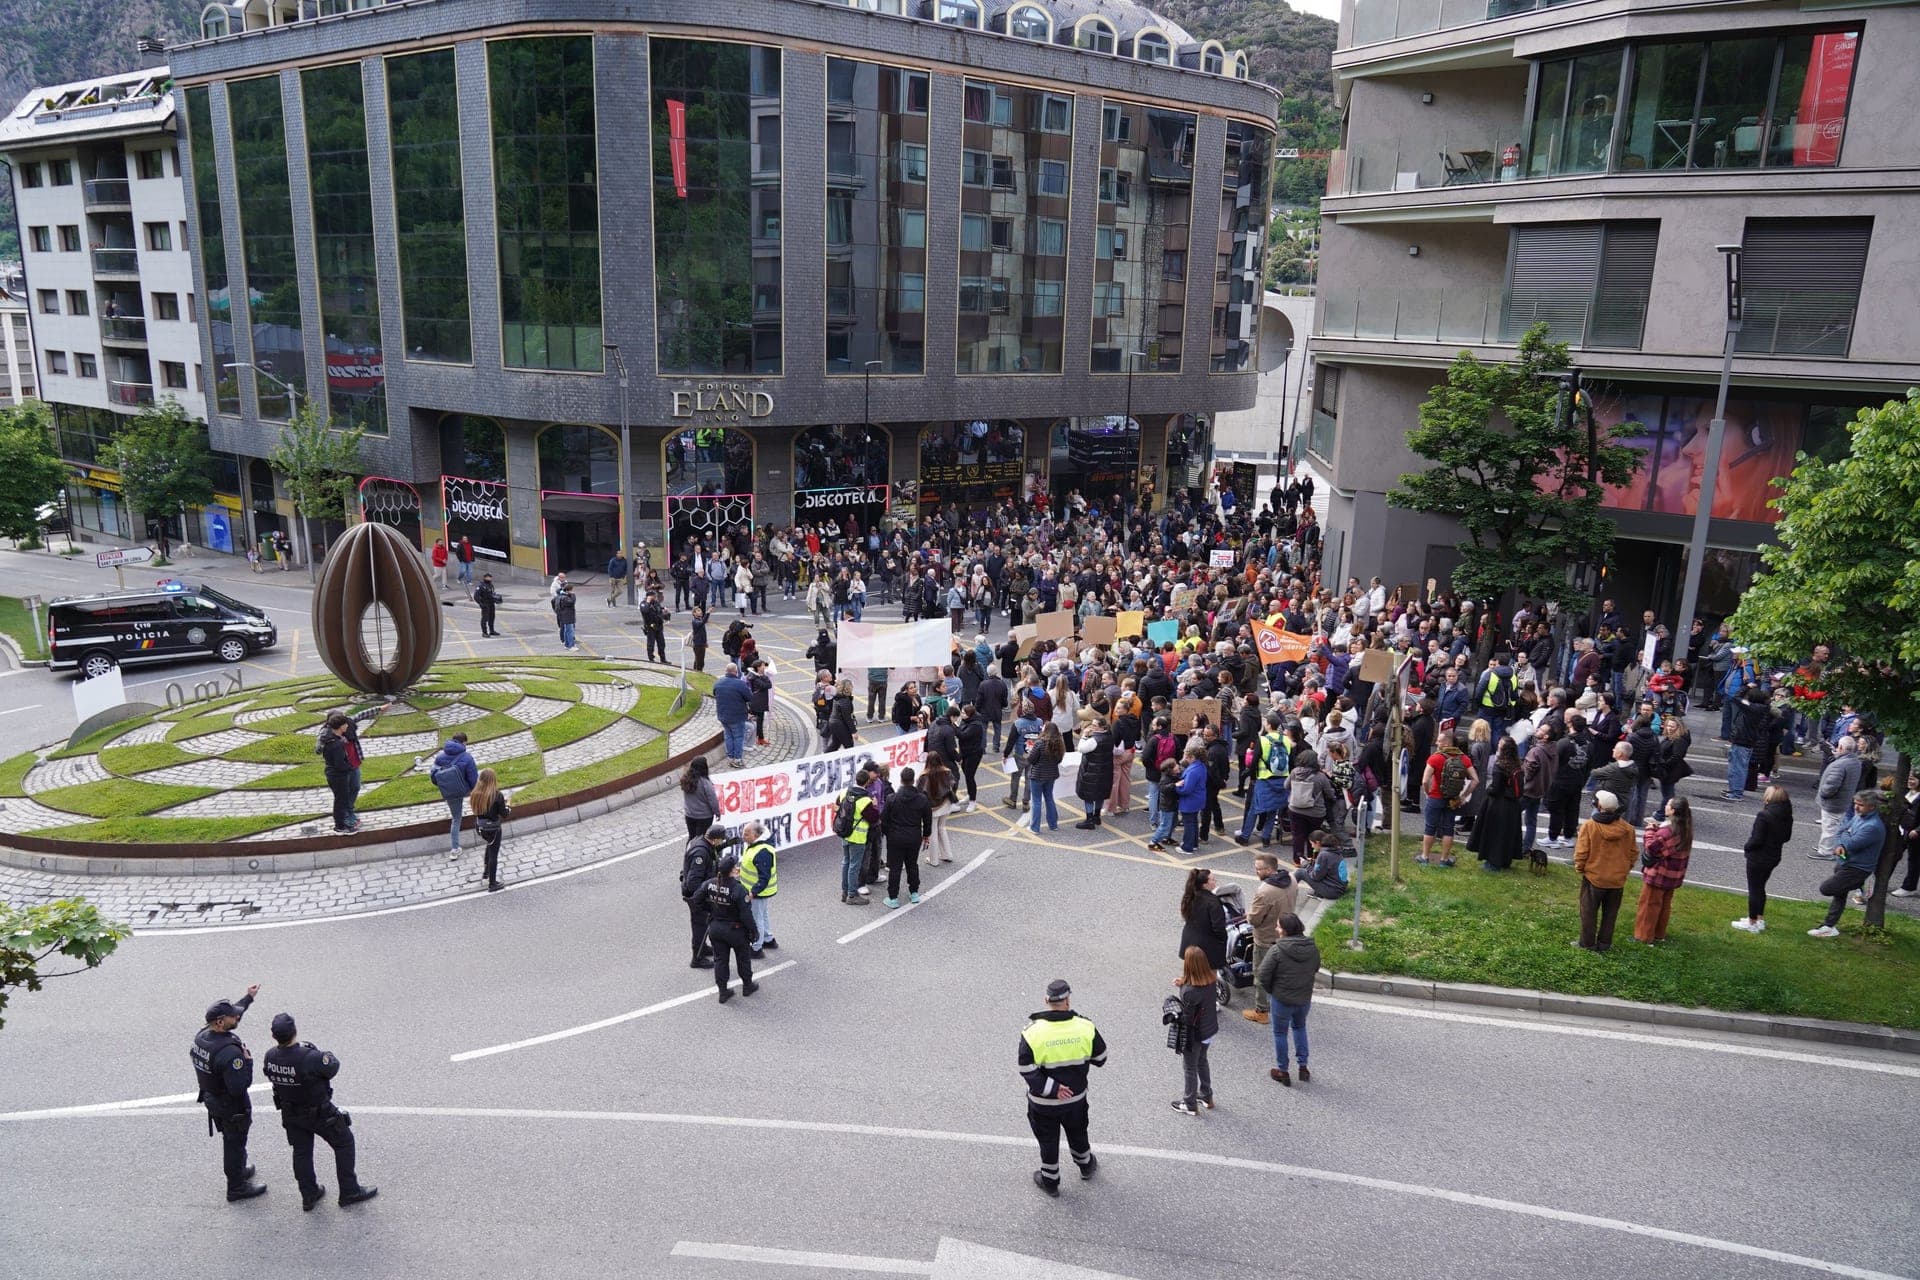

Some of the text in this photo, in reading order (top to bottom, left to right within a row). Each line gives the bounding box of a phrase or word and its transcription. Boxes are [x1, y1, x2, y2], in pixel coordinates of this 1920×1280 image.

[672, 391, 774, 418] ELAND
[805, 489, 877, 508] DISCOTECA
[452, 500, 503, 520] DISCOTECA
[117, 630, 170, 641] POLICIA
[707, 882, 730, 896] POLCIA
[266, 1061, 297, 1077] POLICIA
